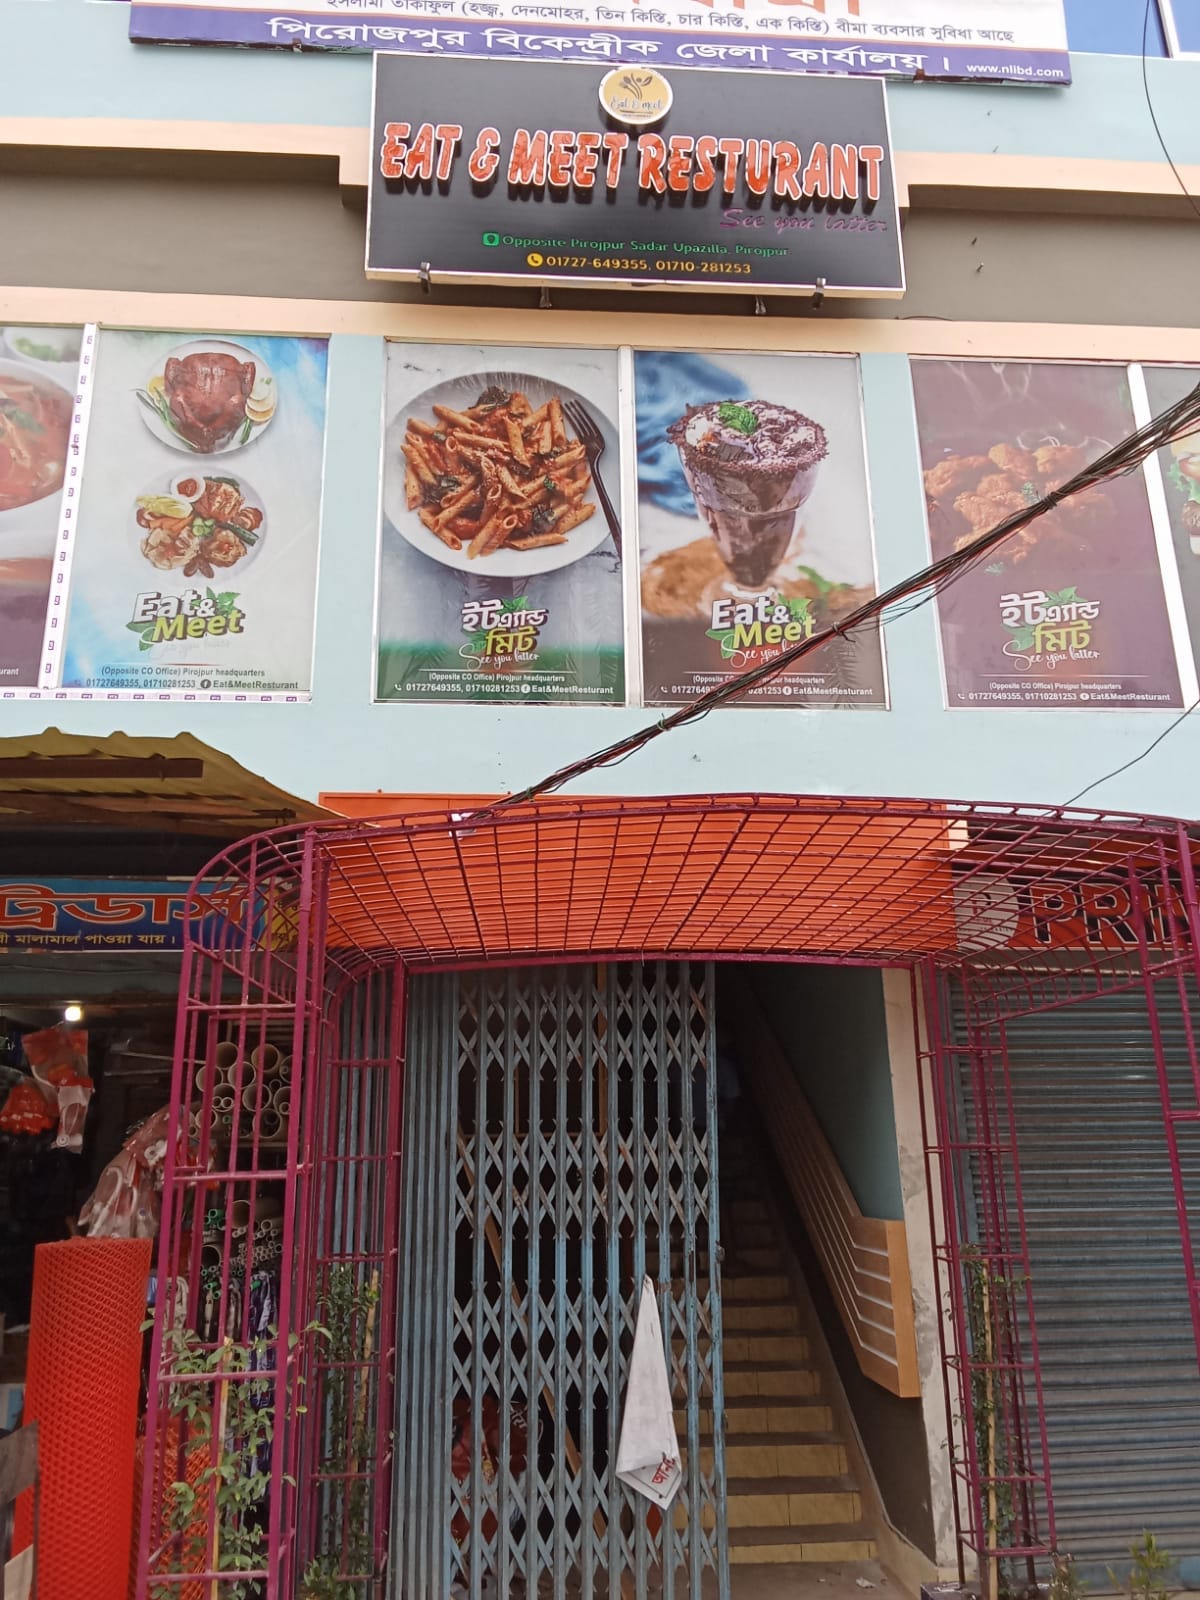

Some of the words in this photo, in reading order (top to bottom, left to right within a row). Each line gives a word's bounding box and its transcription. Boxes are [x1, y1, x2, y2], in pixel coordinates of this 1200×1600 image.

[597, 7, 625, 20] তিন
[631, 9, 671, 25] কিস্তি,
[678, 14, 703, 26] চার
[709, 13, 749, 30] কিস্তি,
[756, 18, 783, 29] এক
[836, 18, 867, 34] বীমা
[930, 24, 973, 42] সুবিধা
[977, 30, 1016, 43] আছে
[265, 16, 473, 48] পিরোজপুর
[676, 41, 777, 63] জেলা
[782, 45, 929, 70] কার্যালয়
[966, 64, 1064, 77] www.nlibd.com
[379, 121, 463, 182] EAT
[468, 126, 500, 183] &
[508, 128, 629, 191] MEET
[637, 132, 885, 200] RESTURANT
[720, 207, 765, 230] See
[502, 235, 567, 249] Opposite
[571, 238, 625, 251] Pirojpur
[631, 240, 667, 252] Sadar
[655, 260, 751, 274] 01710-281253
[151, 608, 246, 644] Meet
[732, 615, 816, 649] Meet
[1032, 620, 1092, 654] মিট
[485, 626, 539, 656] মিট
[721, 633, 757, 669] See
[1002, 640, 1043, 671] See
[1046, 653, 1068, 670] you
[101, 665, 139, 677] (Opposite
[141, 667, 153, 676] CO
[155, 666, 181, 677] Office)
[183, 667, 214, 678] Pirojpur
[216, 668, 265, 678] headquarters
[459, 643, 491, 671] See
[493, 655, 512, 670] you
[143, 680, 196, 689] 01710281253
[465, 684, 520, 693] 01710281253
[16, 933, 80, 945] মালামাল
[84, 934, 132, 945] পাওয়া
[138, 934, 166, 945] যায়
